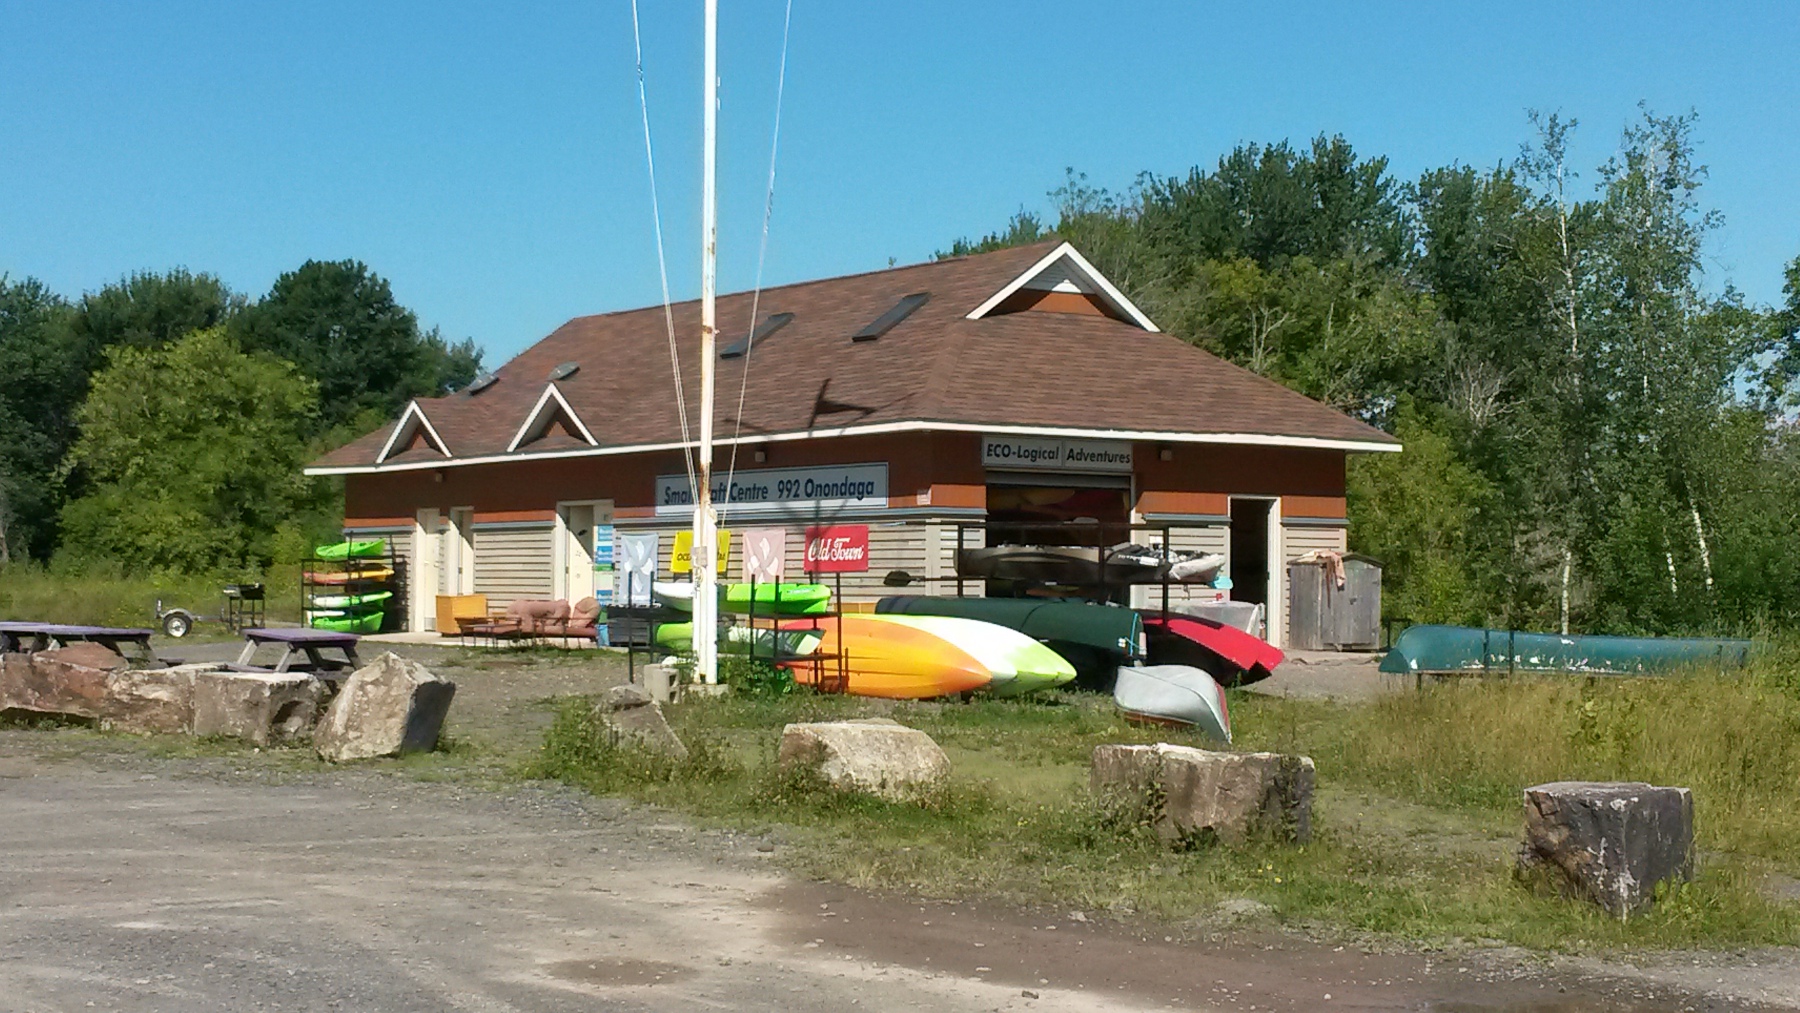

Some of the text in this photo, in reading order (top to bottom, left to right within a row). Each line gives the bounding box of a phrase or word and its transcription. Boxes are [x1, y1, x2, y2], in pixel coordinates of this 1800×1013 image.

[986, 443, 1131, 464] ECO-Logical Adventures
[664, 486, 696, 505] Smal
[729, 481, 769, 501] Centre
[778, 479, 800, 498] 992
[804, 475, 875, 501] Onondaga
[807, 537, 865, 562] Old Town
